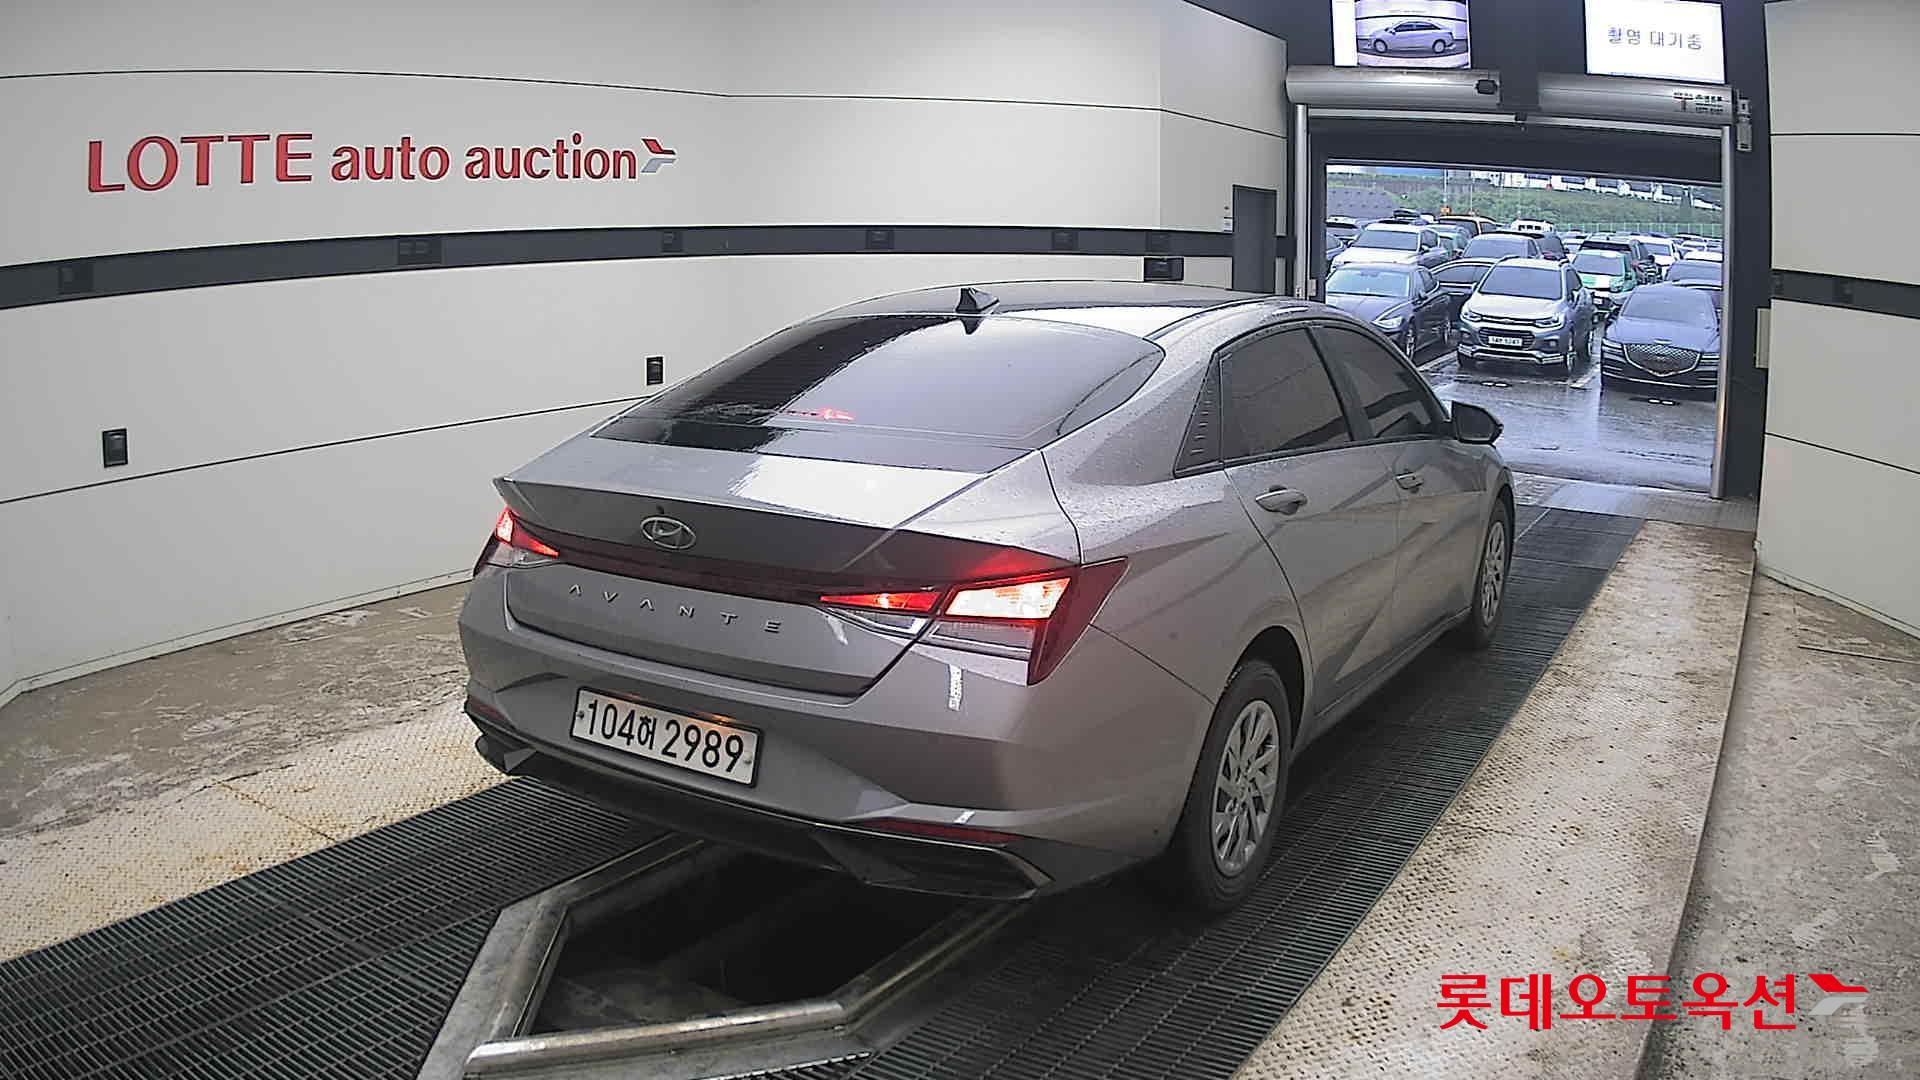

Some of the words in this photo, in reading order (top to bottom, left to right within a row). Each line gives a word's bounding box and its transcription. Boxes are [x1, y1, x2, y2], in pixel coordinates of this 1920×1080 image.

[88, 134, 313, 193] LOTTE
[331, 136, 450, 181] auto
[464, 132, 637, 180] auction
[568, 583, 782, 634] AVANTE
[661, 719, 744, 773] 2989
